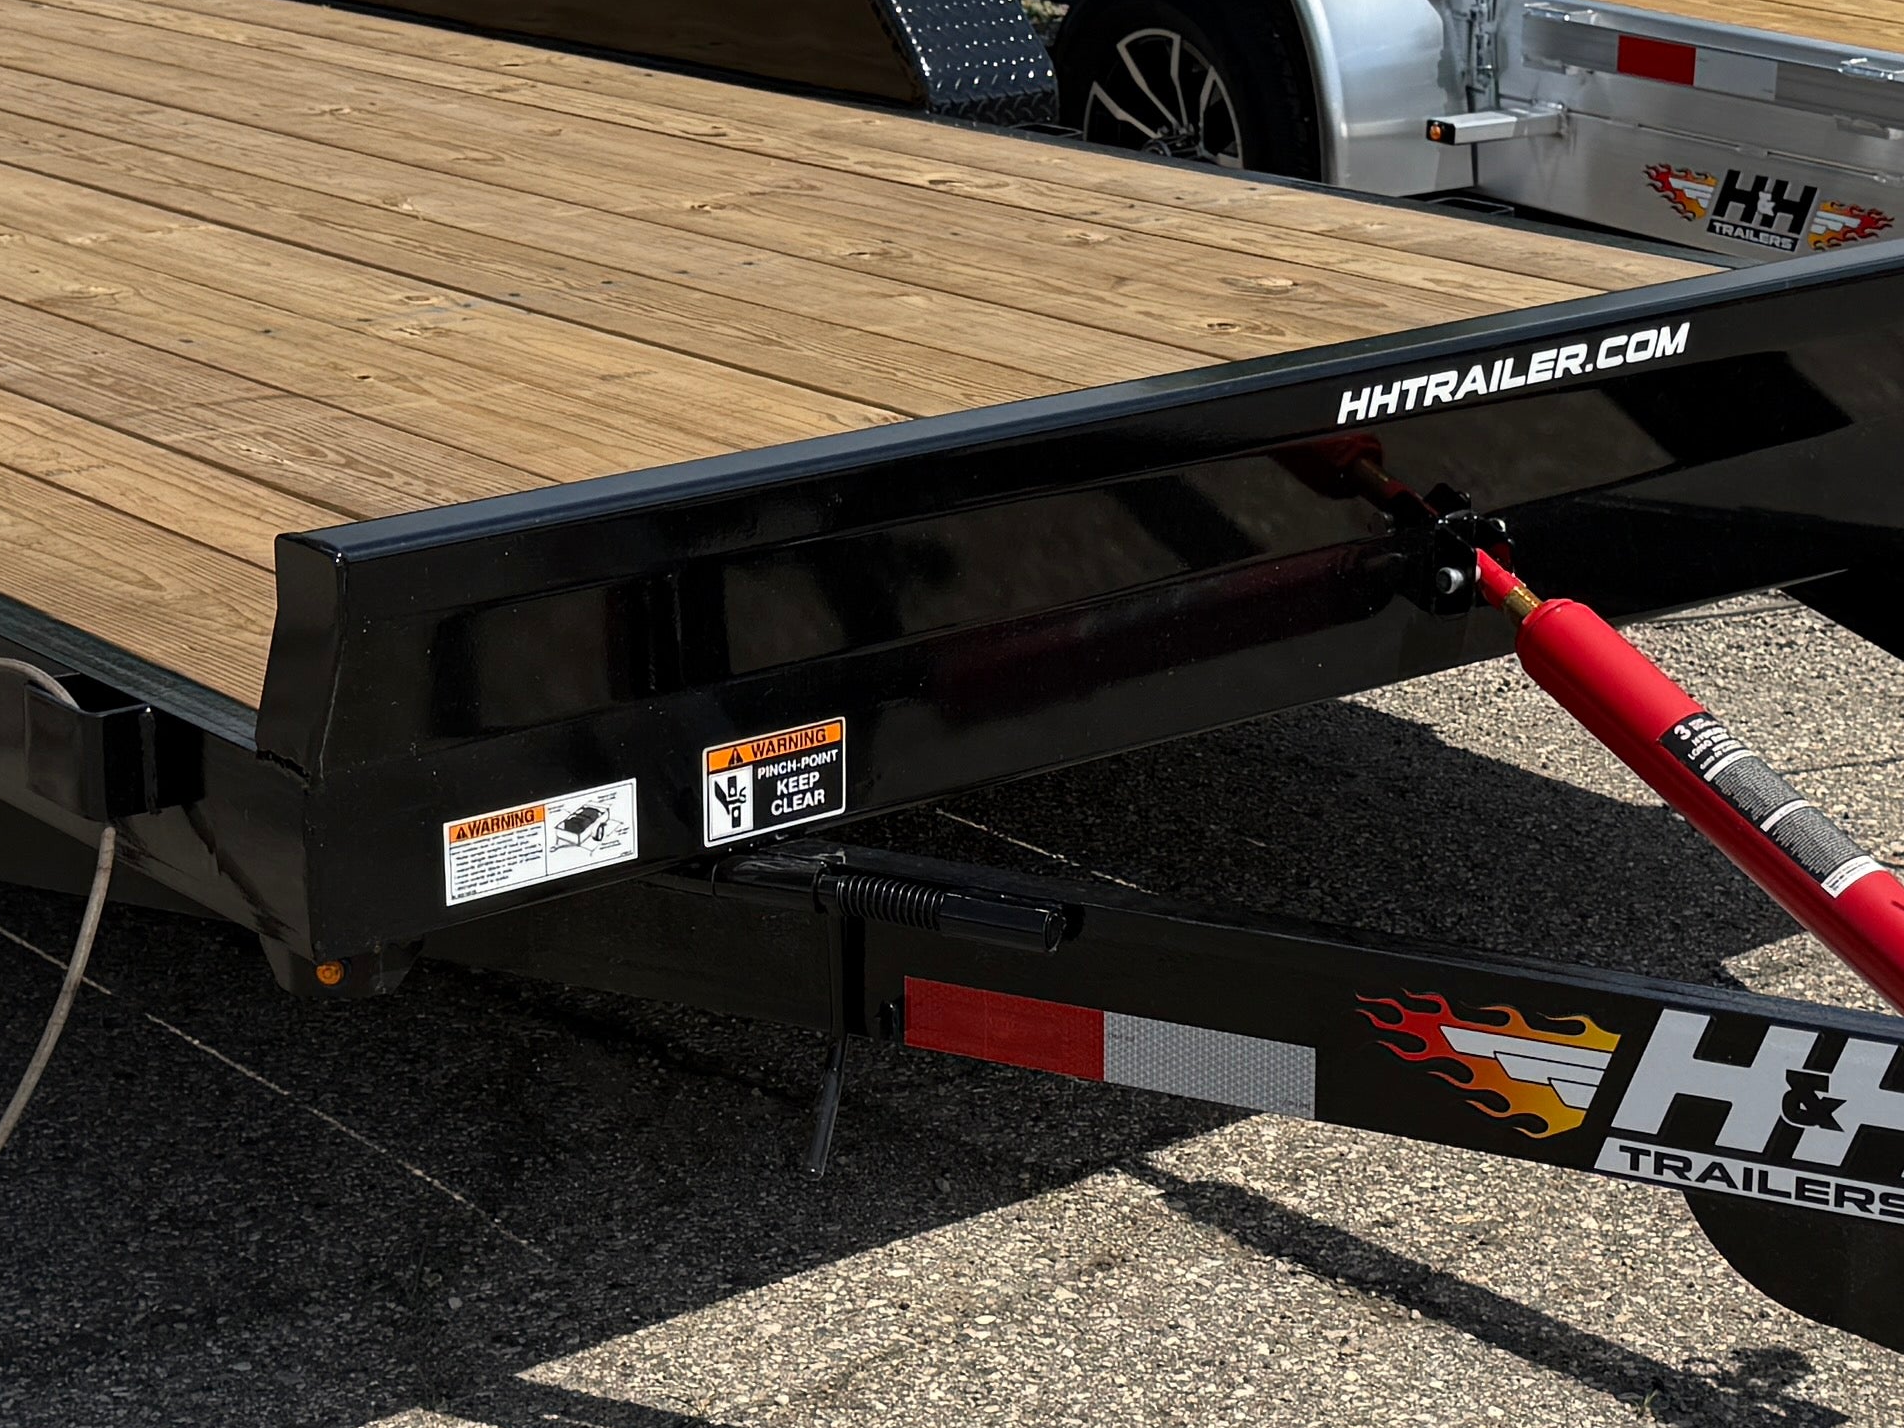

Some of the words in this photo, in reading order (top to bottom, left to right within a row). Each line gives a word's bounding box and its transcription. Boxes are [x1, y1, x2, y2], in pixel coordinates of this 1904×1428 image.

[1712, 169, 1818, 235] H&H
[1712, 222, 1794, 251] TRAILERS
[1336, 322, 1691, 425] HHTRAILER.COM
[751, 728, 827, 759] WARNING
[1674, 723, 1692, 741] 3
[757, 749, 838, 780] PINCH-POINT
[776, 771, 820, 796] KEEP
[771, 789, 825, 816] CLEAR
[468, 809, 535, 839] WARNING
